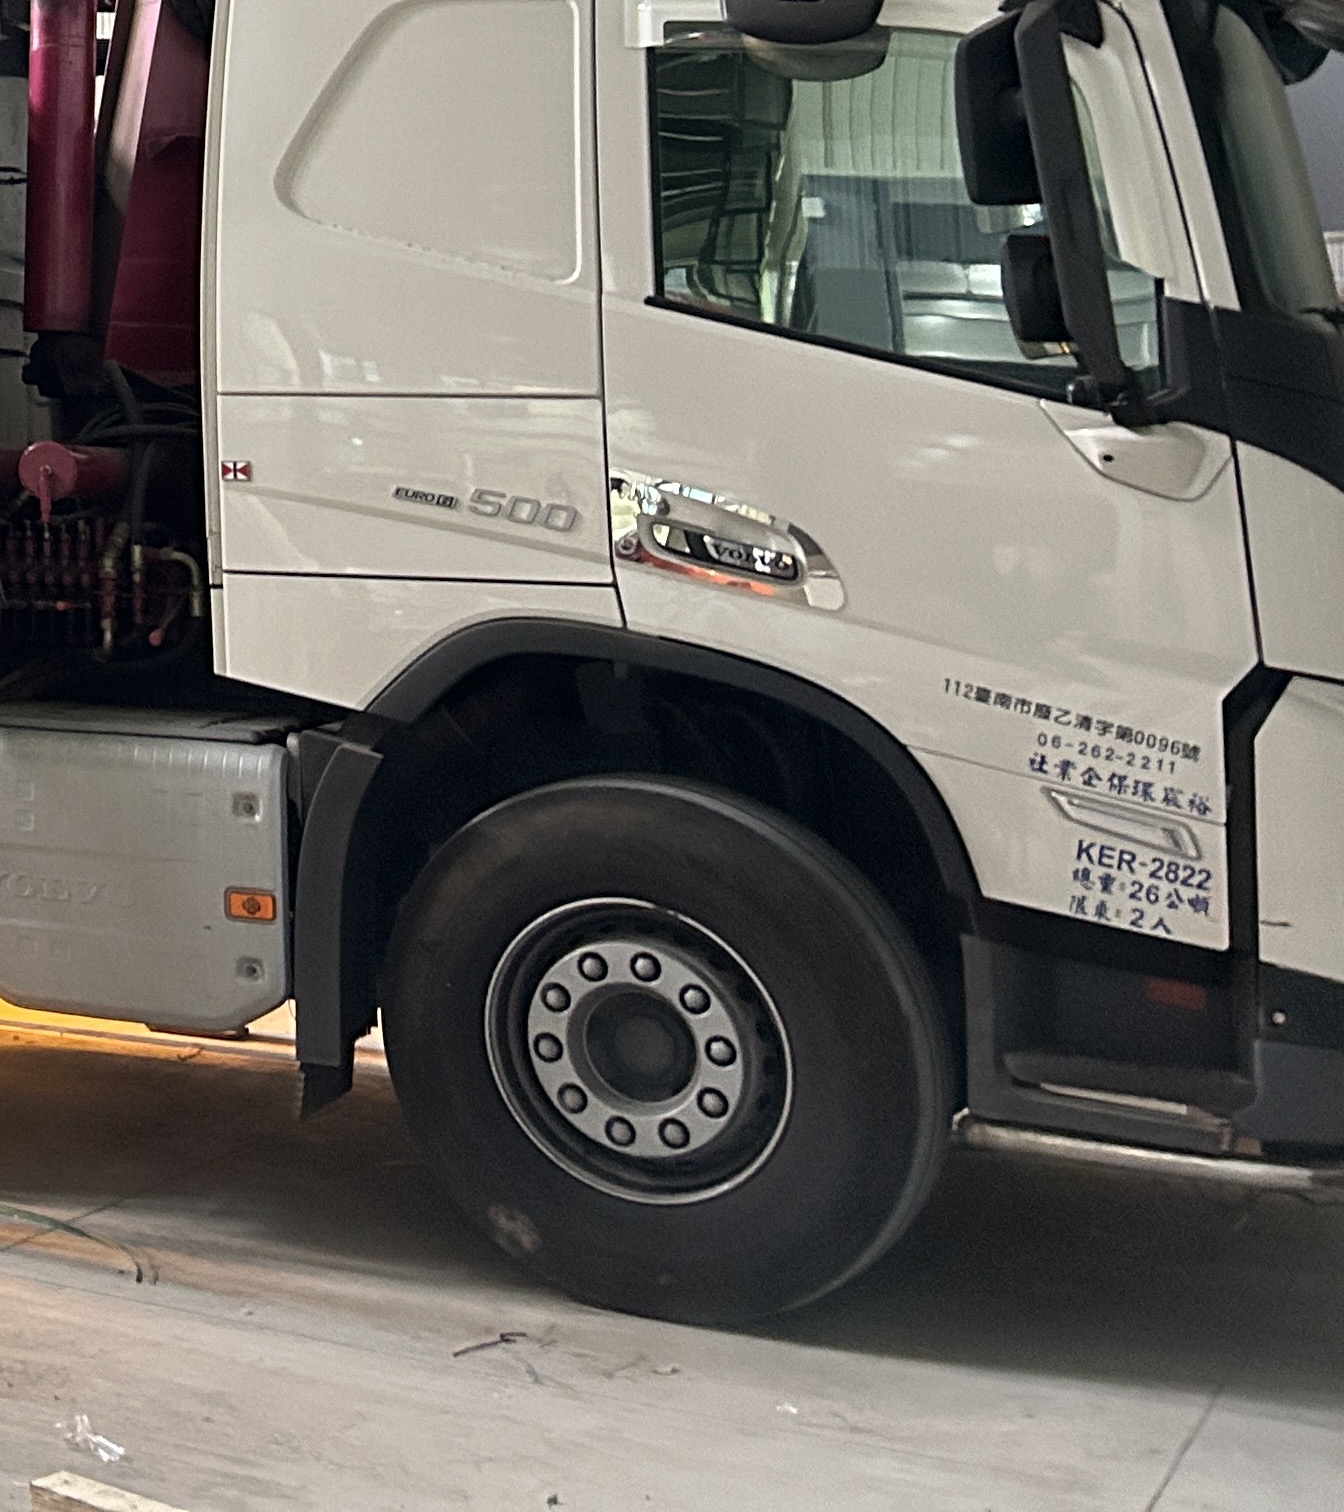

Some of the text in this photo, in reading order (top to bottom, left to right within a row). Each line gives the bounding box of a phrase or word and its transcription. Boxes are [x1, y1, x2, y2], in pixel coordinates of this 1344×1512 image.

[468, 488, 582, 533] 500
[1037, 732, 1177, 774] 06-262-2211
[1076, 839, 1212, 890] KER-2822
